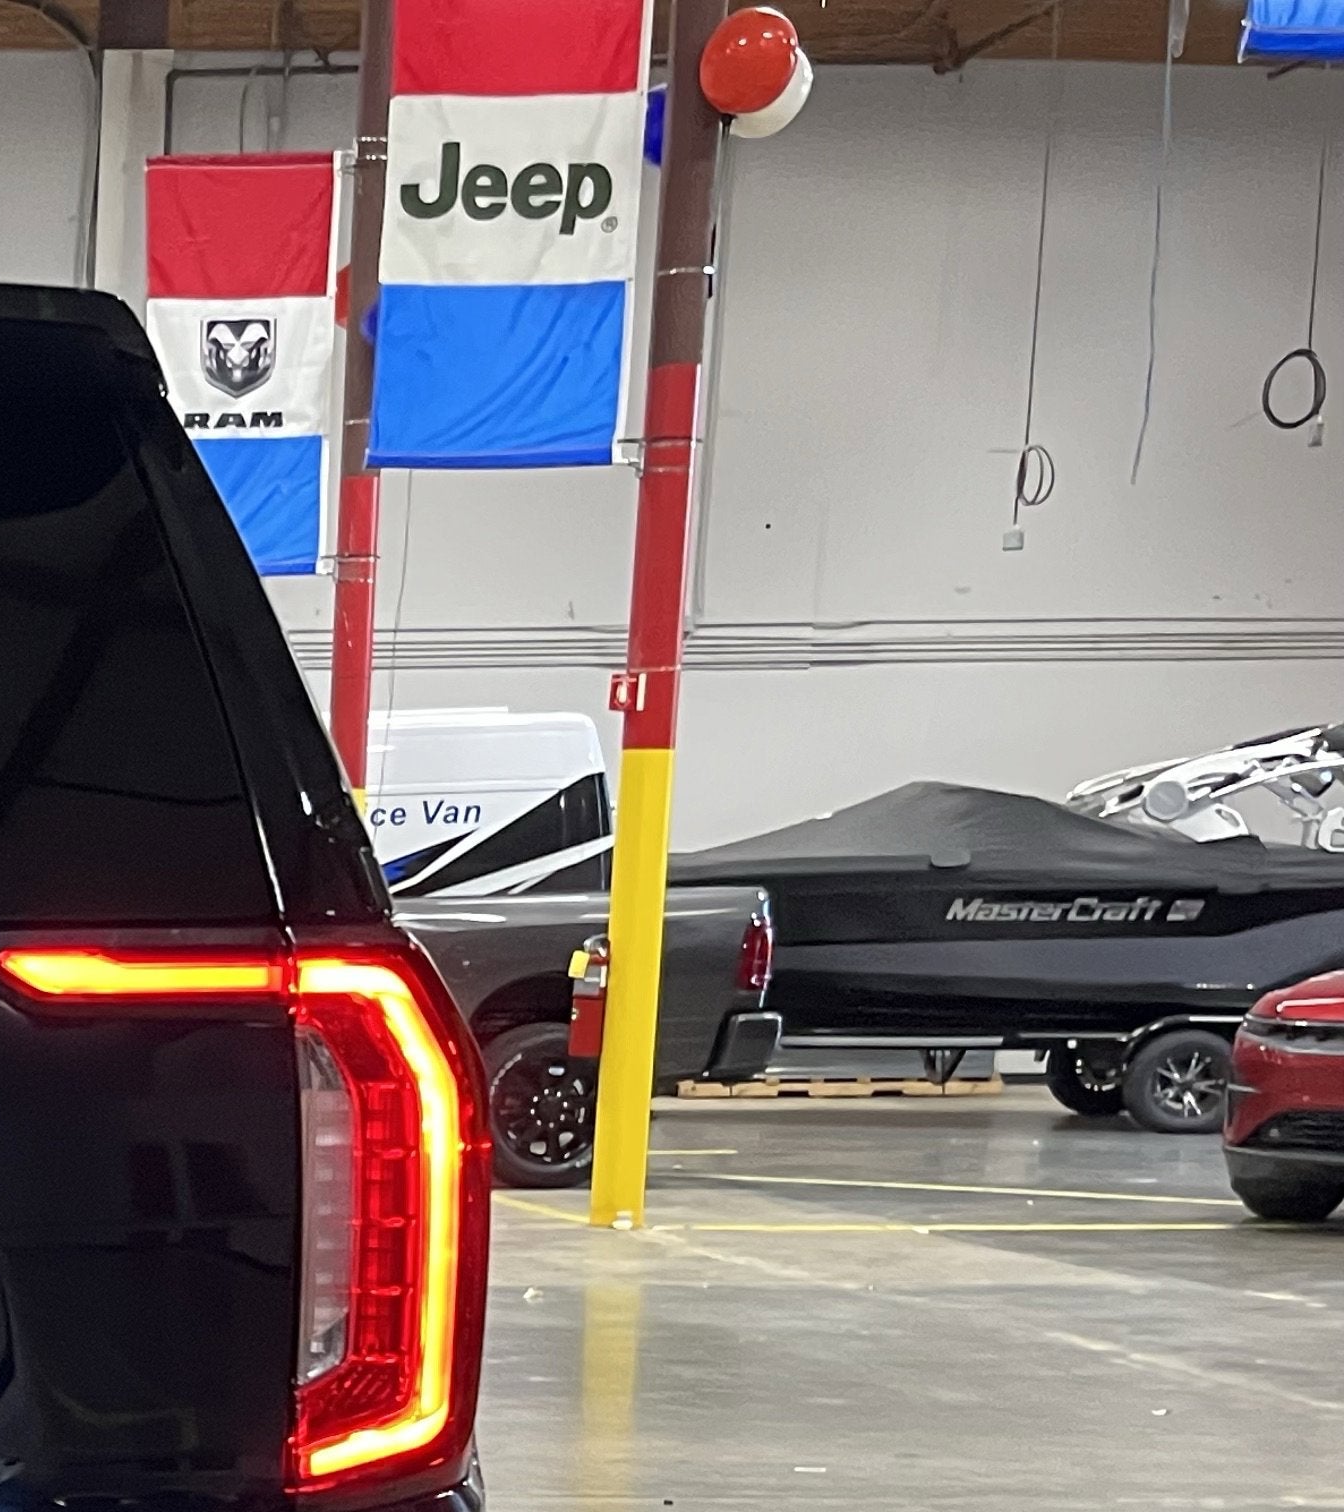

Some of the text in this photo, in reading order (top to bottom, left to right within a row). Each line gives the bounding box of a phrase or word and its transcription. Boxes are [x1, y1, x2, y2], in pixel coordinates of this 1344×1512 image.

[400, 142, 612, 235] Jeep
[184, 411, 284, 429] RAM
[422, 800, 481, 825] Van
[945, 896, 1163, 922] MasterCraft
